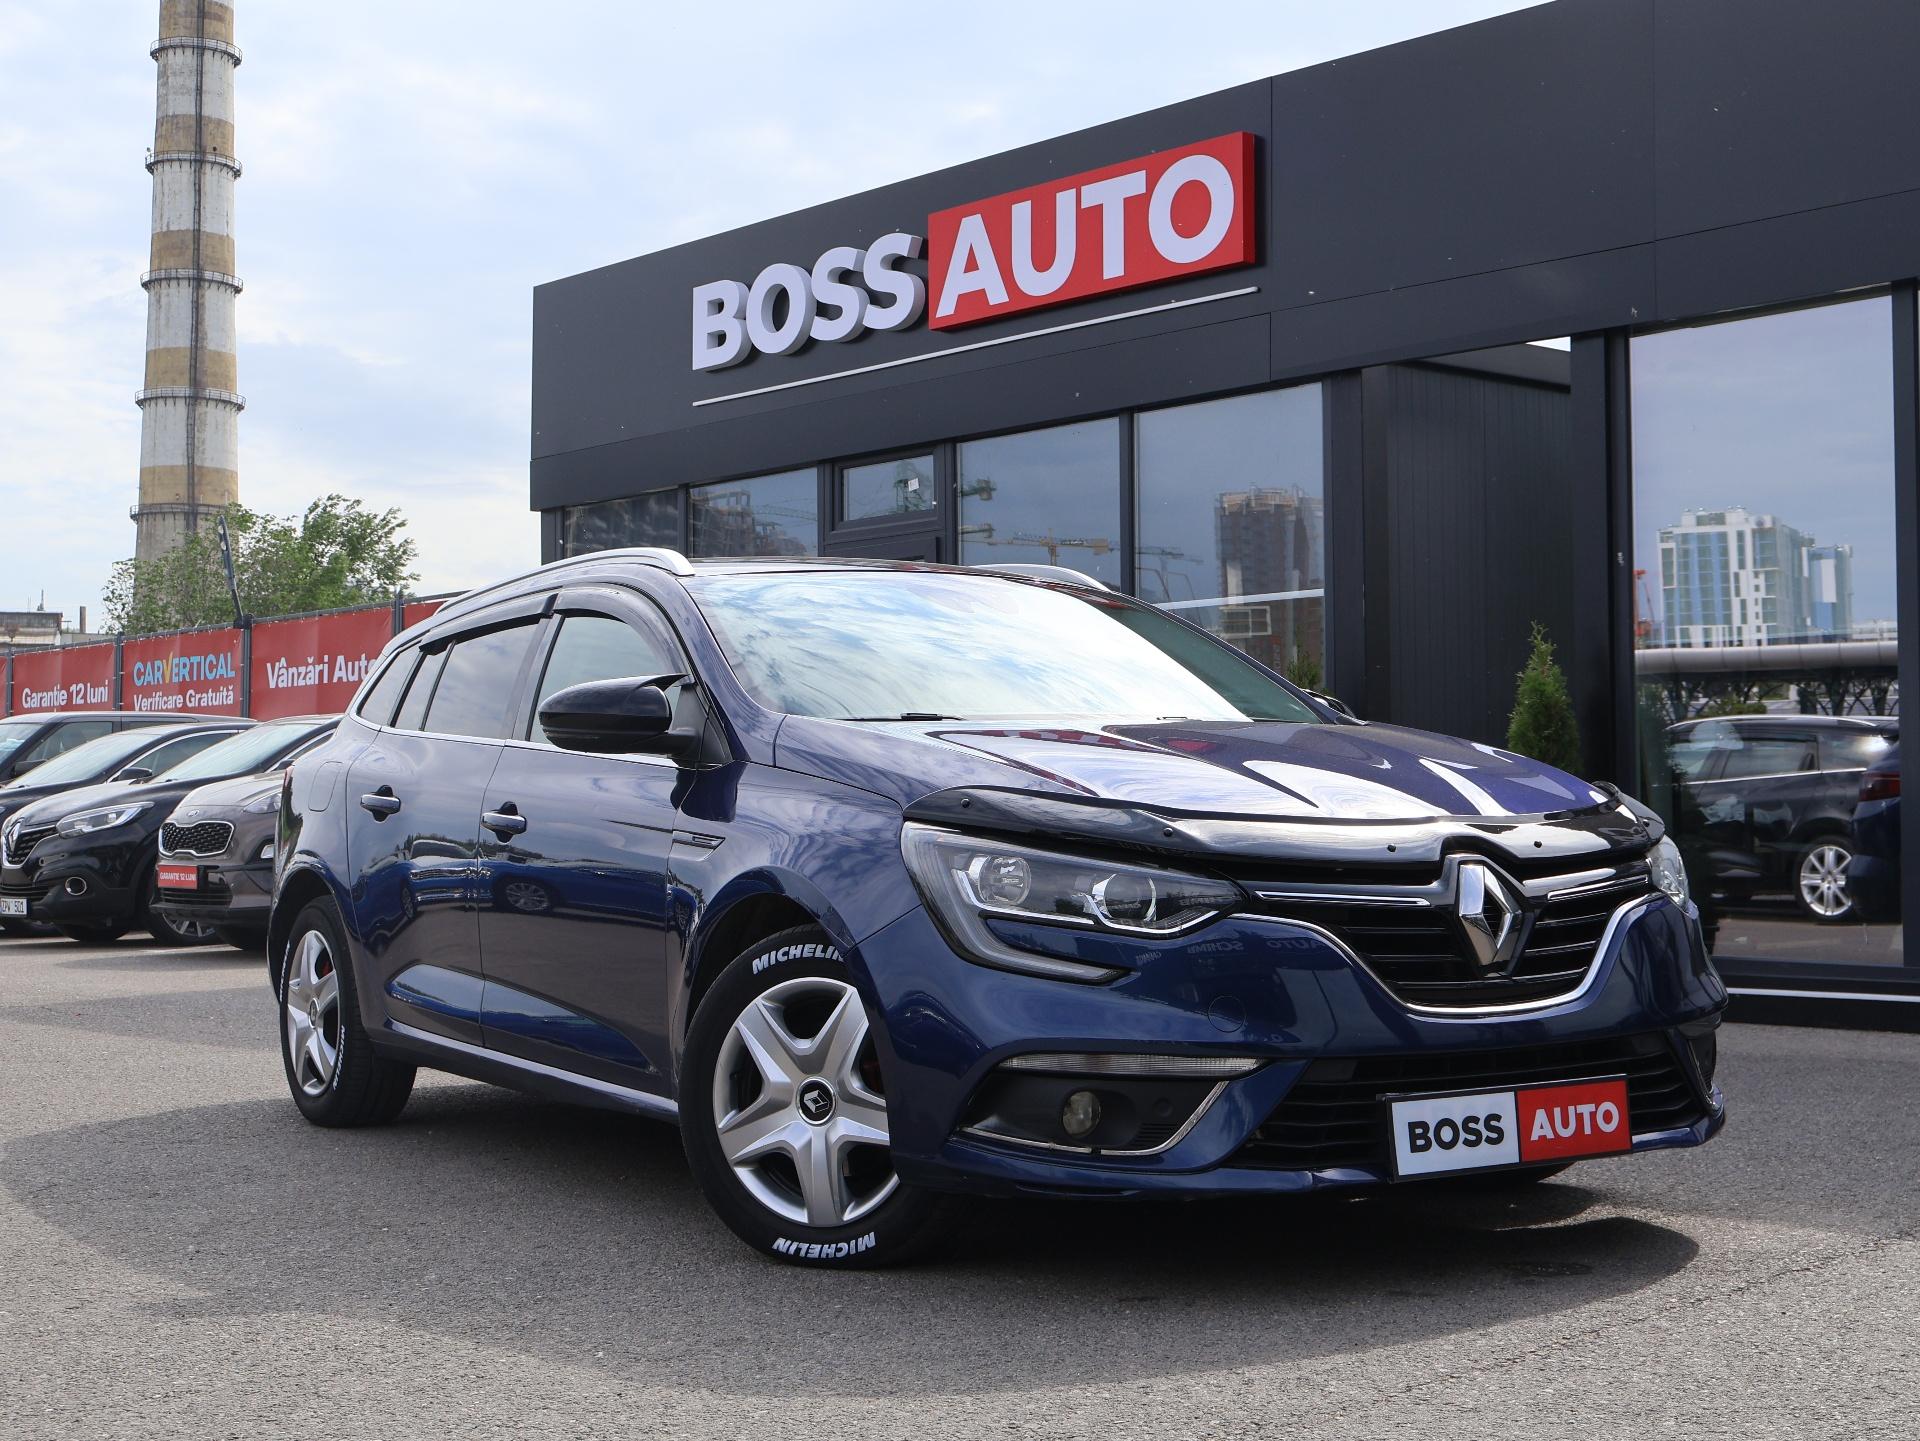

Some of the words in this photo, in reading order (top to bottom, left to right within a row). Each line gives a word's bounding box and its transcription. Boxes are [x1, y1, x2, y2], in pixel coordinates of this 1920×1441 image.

[692, 232, 926, 370] BOSS
[936, 154, 1235, 318] AUTO
[133, 652, 236, 687] CARVERTICAL
[266, 655, 329, 689] Vânzări
[69, 683, 84, 705] 12
[86, 680, 109, 704] luni
[133, 691, 183, 712] Verificare
[185, 685, 234, 708] Gratuită
[1407, 1113, 1505, 1154] BOSS
[1530, 1101, 1620, 1141] AUTO
[772, 1231, 877, 1260] MICHELIN
